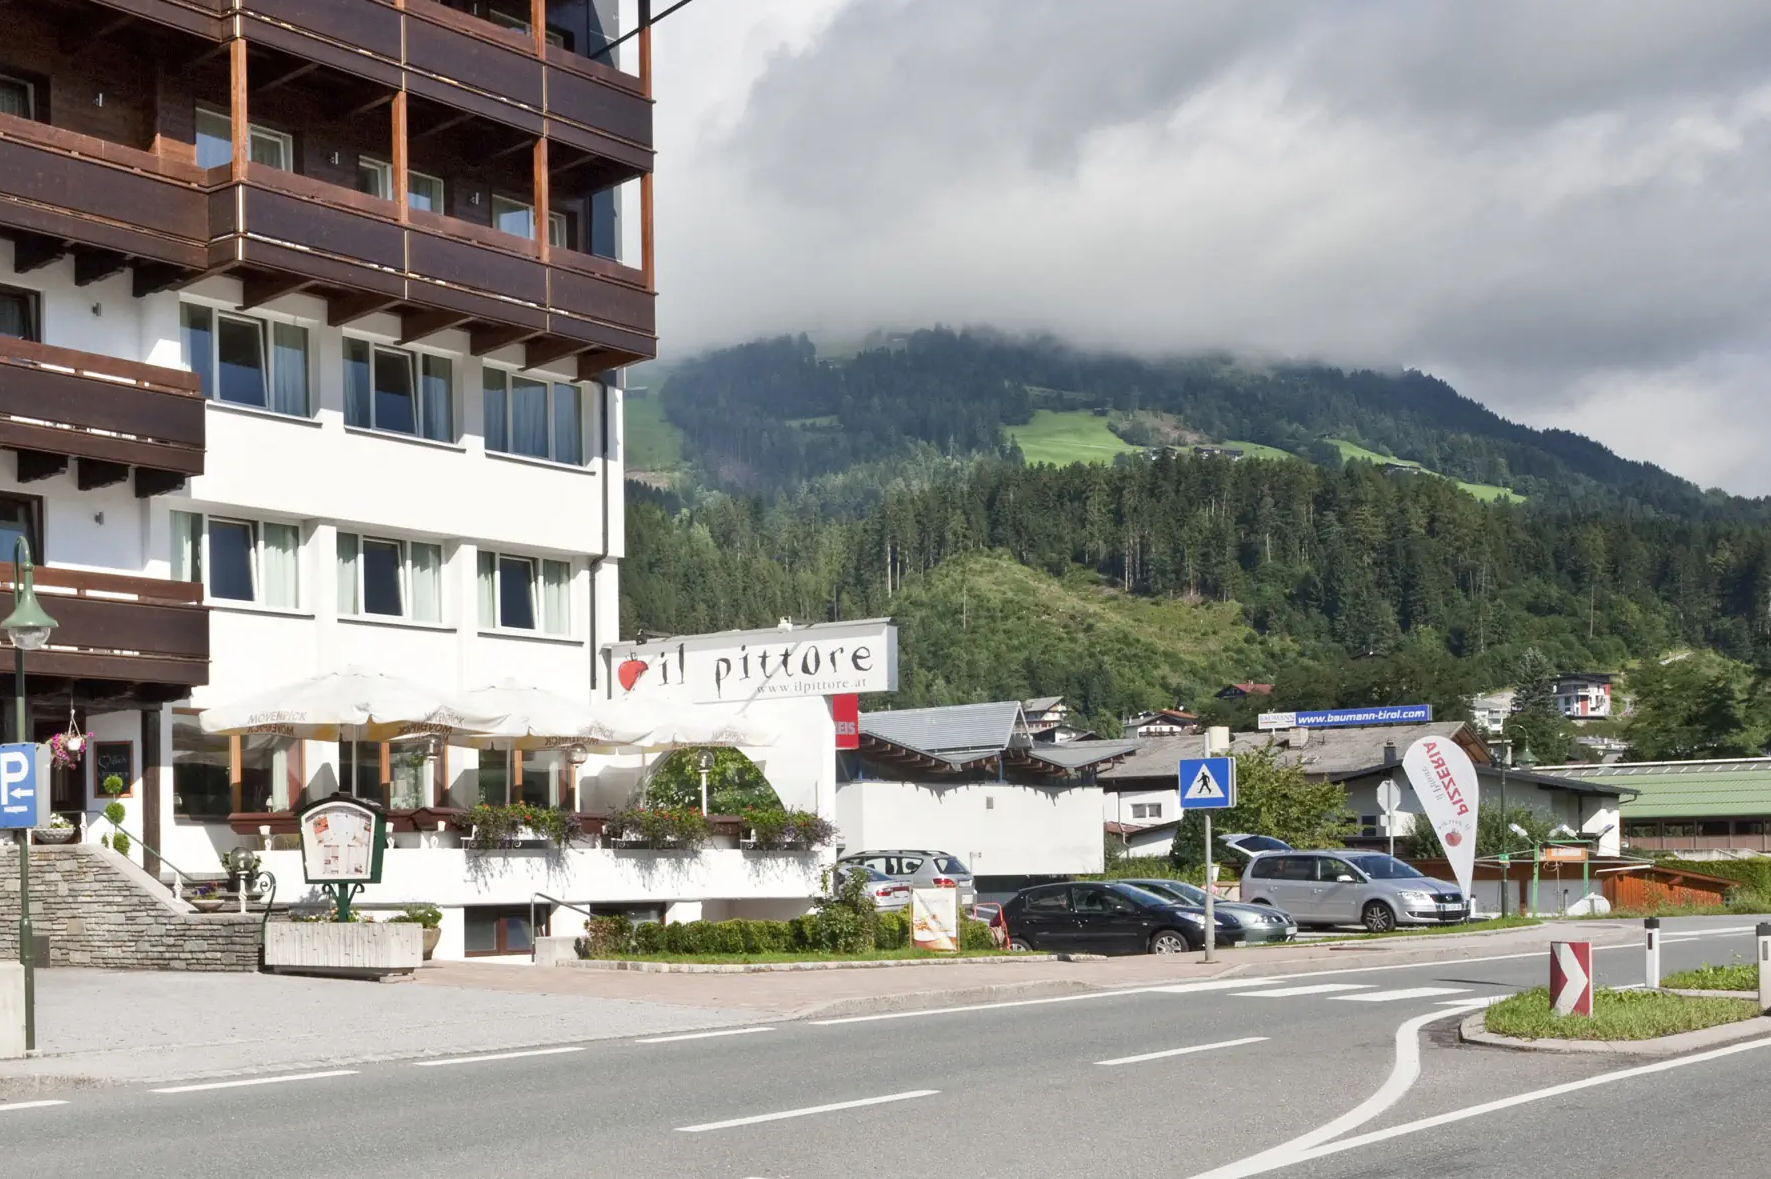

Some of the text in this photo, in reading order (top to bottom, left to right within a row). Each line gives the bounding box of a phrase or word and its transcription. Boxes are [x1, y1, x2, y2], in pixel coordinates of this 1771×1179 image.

[659, 643, 874, 700] il pittore
[757, 678, 867, 694] www.ilpittore.at
[1298, 709, 1426, 724] www.baumann-tirol.com
[0, 752, 29, 805] P
